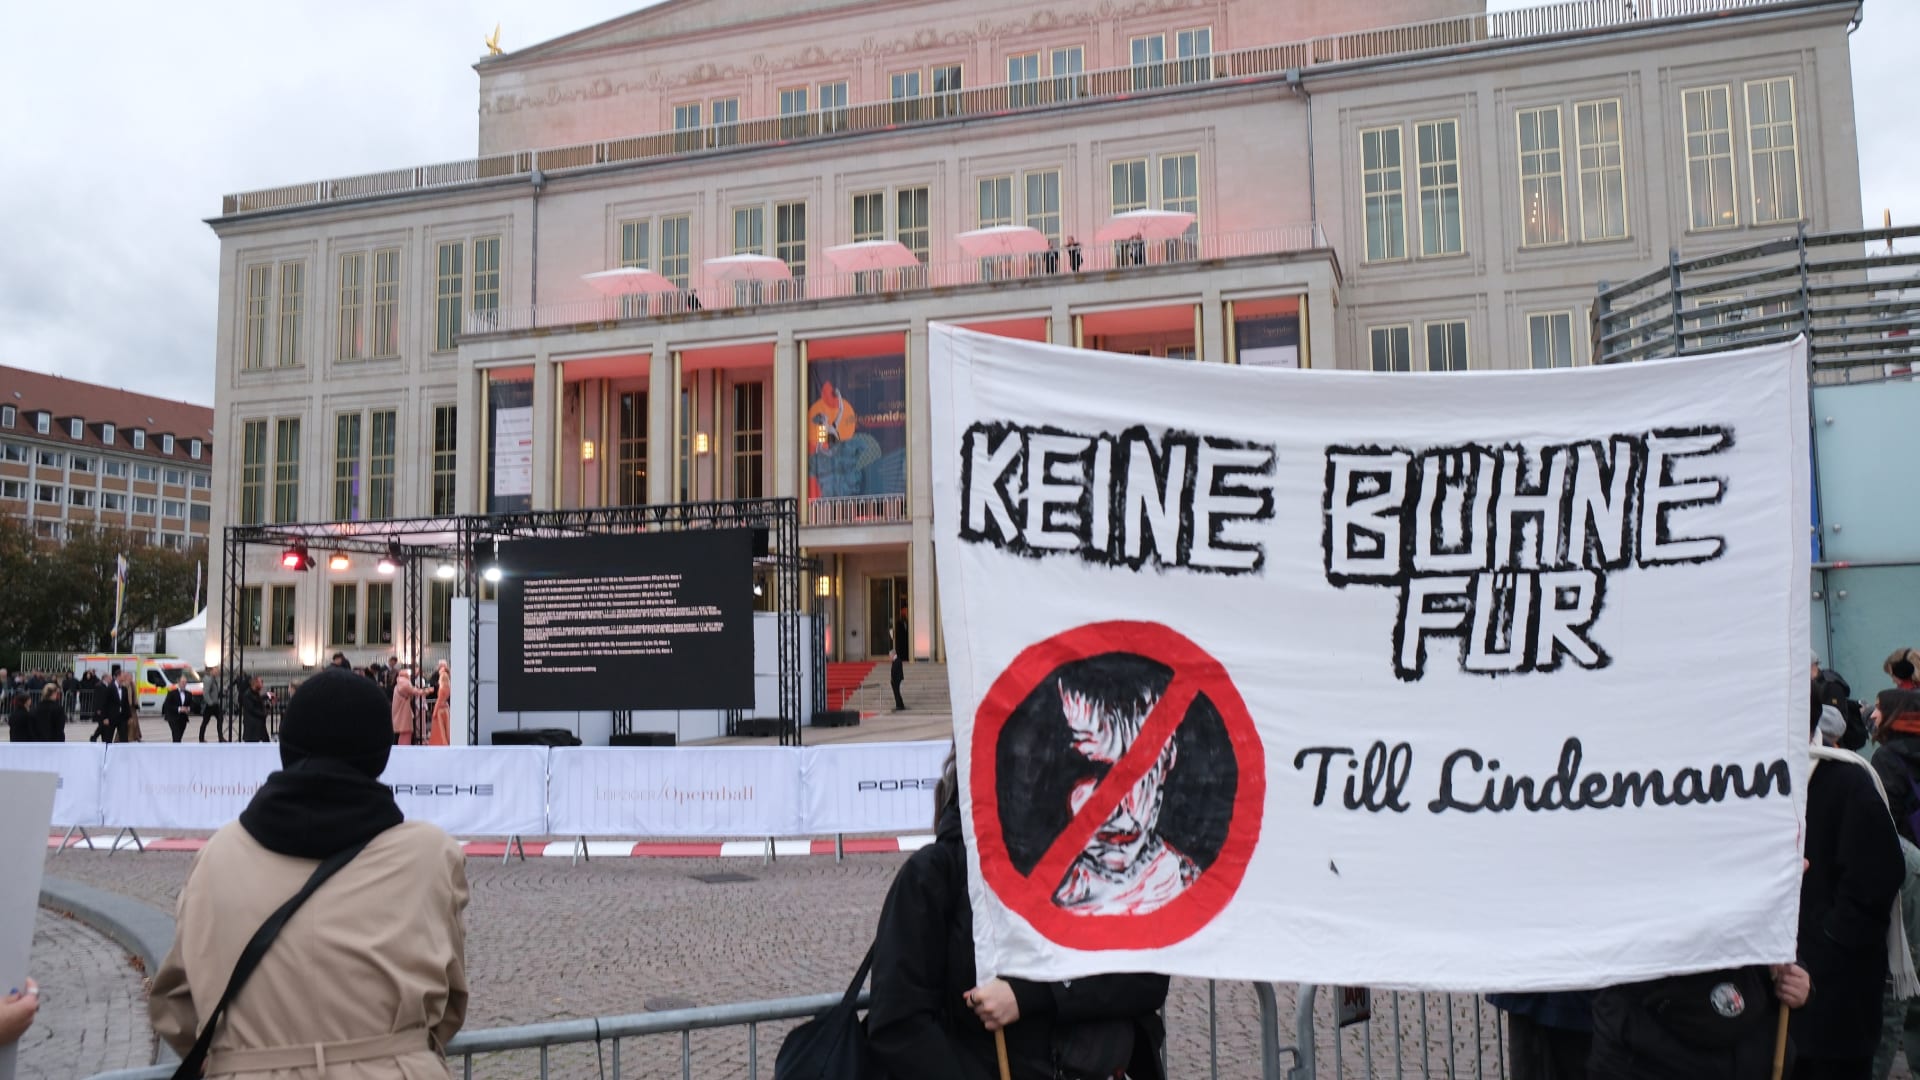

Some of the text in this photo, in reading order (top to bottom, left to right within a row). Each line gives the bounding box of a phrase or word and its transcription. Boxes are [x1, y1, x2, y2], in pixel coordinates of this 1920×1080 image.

[958, 421, 1734, 588] KEINE BÜHNE
[1393, 567, 1612, 682] FÜR
[389, 783, 493, 796] RSCHE
[858, 779, 940, 793] PORS
[1294, 737, 1792, 813] Till Lindemann
